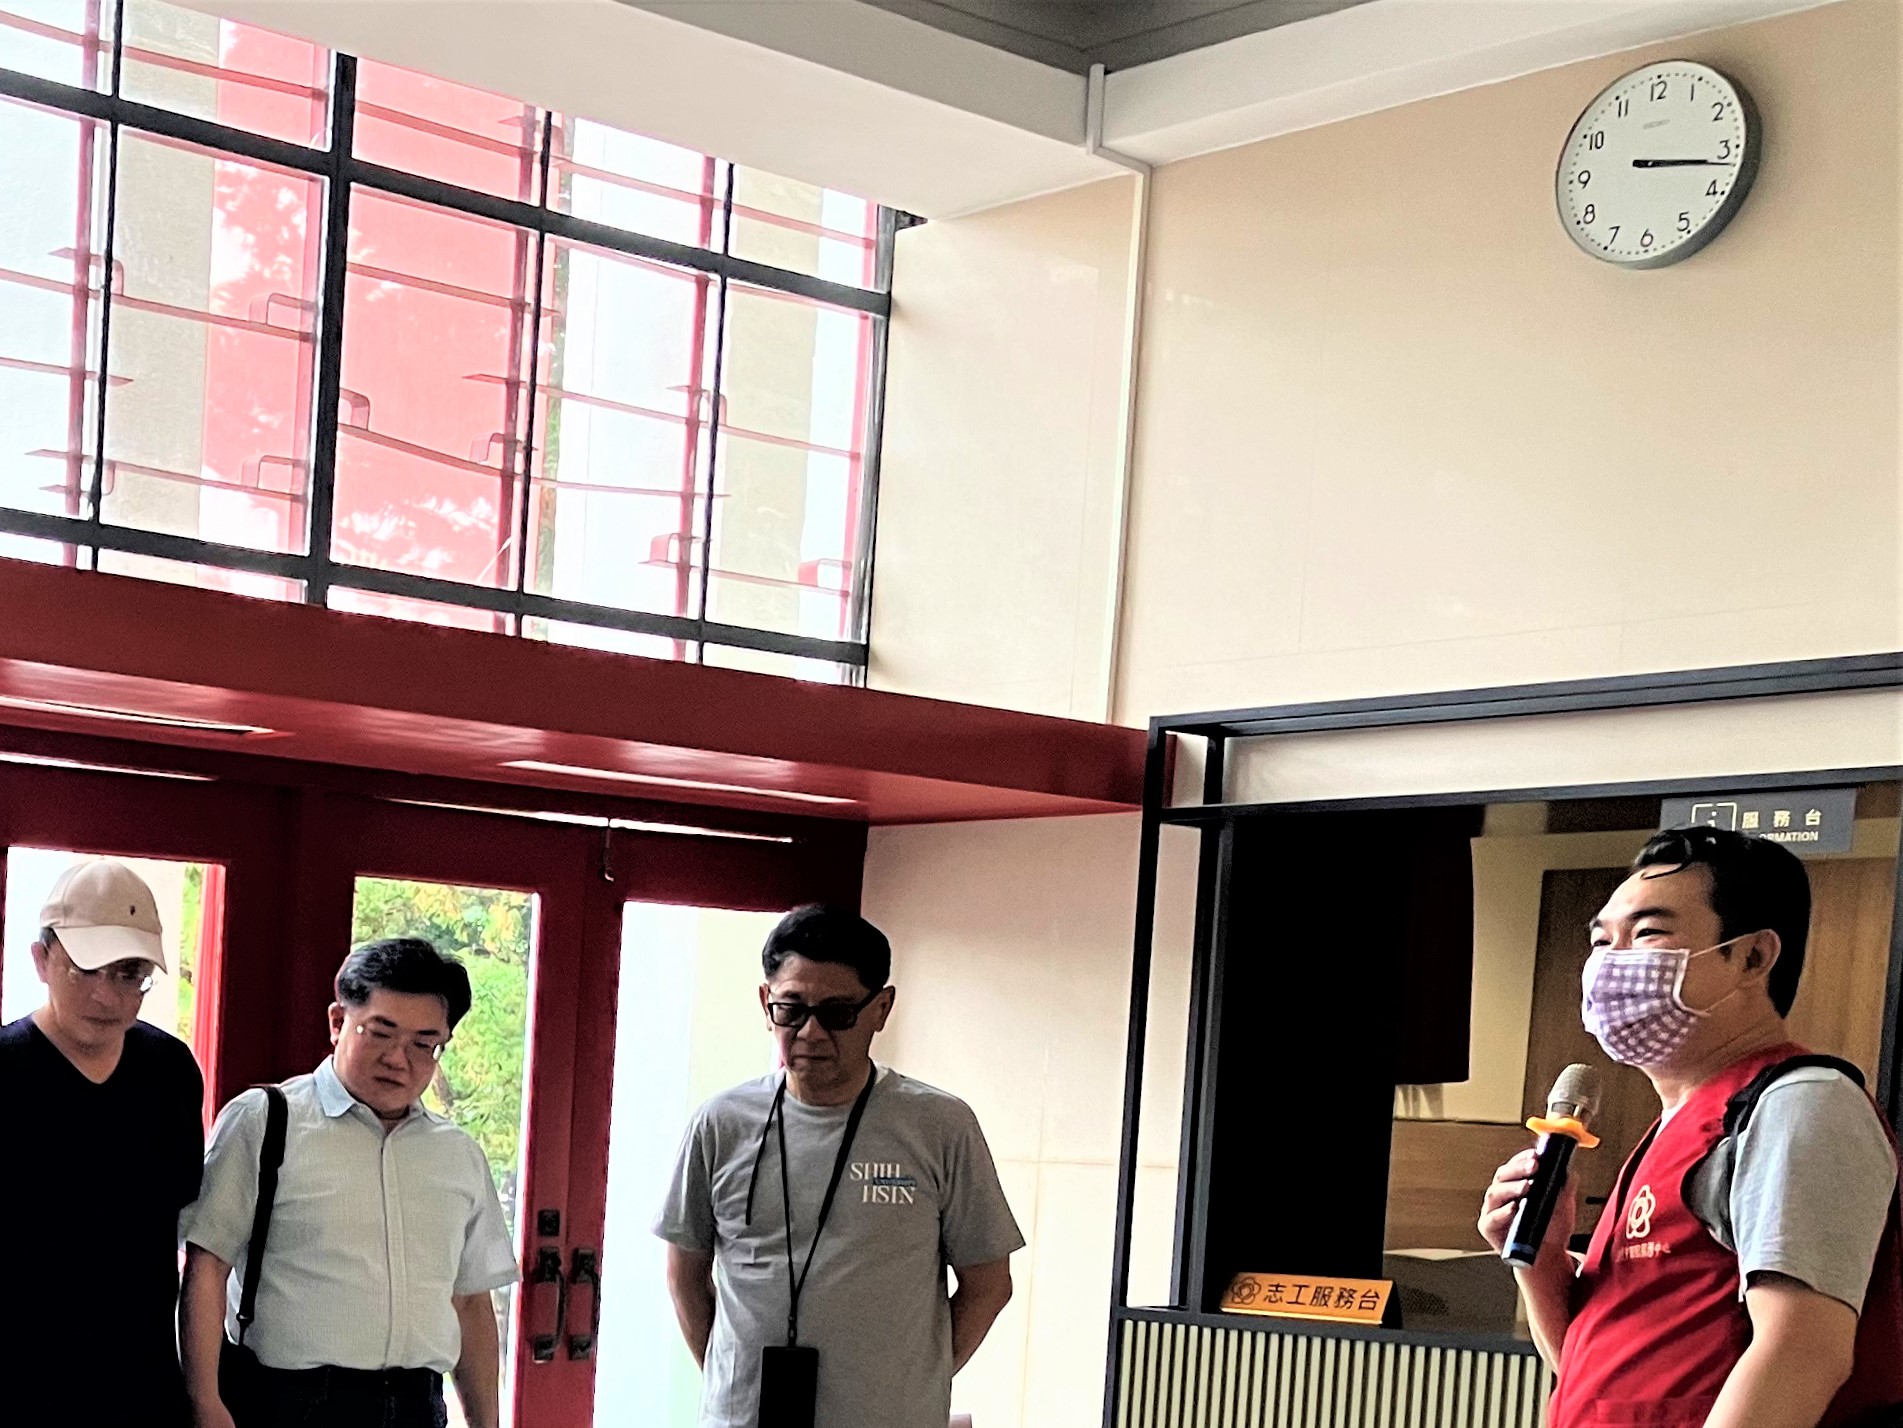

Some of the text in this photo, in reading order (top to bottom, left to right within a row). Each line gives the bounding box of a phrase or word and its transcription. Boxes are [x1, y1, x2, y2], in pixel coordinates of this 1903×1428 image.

[1650, 81, 1668, 101] 12
[1618, 100, 1629, 118] 11
[1711, 102, 1724, 122] 2
[1589, 131, 1604, 151] 10
[1717, 140, 1731, 160] 3
[1578, 170, 1591, 189] 9
[1705, 179, 1718, 197] 4
[1583, 204, 1596, 225] 8
[1677, 212, 1690, 231] 5
[1608, 226, 1621, 245] 7
[1640, 228, 1654, 247] 6
[1742, 808, 1821, 829] 服務台
[1759, 831, 1818, 842] ORMATION
[863, 1185, 916, 1204] HSIN
[1264, 1282, 1381, 1311] 志工服務台
